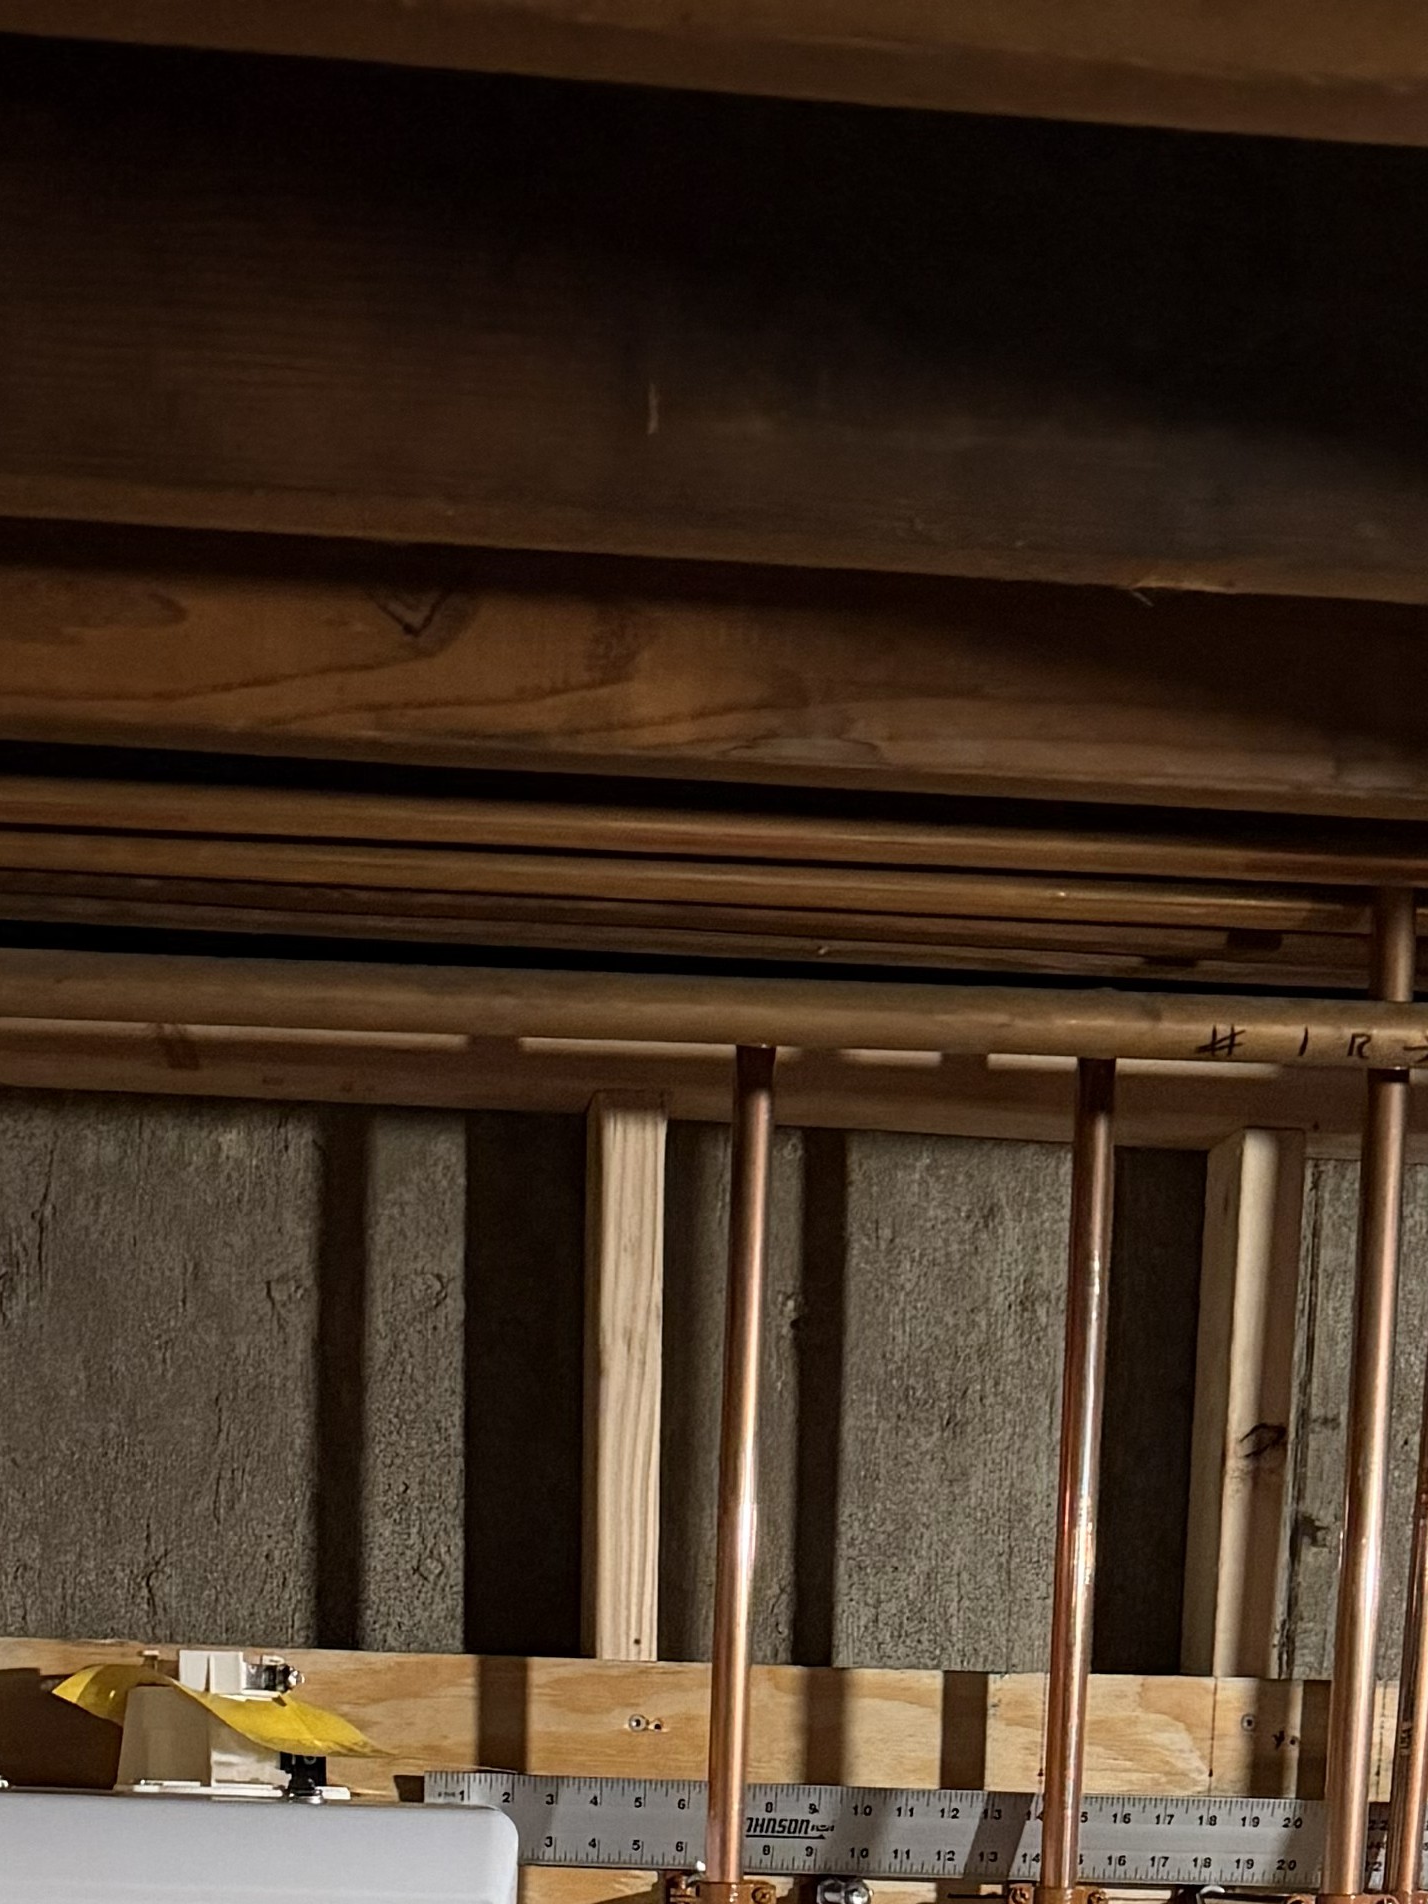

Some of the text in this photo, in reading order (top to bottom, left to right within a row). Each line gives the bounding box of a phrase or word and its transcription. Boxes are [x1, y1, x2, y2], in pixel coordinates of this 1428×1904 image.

[458, 1791, 465, 1802] 1
[502, 1792, 511, 1803] 2
[545, 1794, 554, 1805] 3
[589, 1795, 599, 1806] 4
[634, 1797, 643, 1808] 5
[677, 1799, 686, 1810] 6
[853, 1804, 872, 1816] 10
[896, 1807, 914, 1818] 11
[940, 1808, 959, 1820] 12
[983, 1809, 1002, 1820] 13
[1080, 1812, 1089, 1824] 5
[1112, 1813, 1131, 1824] 16
[1155, 1814, 1175, 1825] 17
[1198, 1815, 1218, 1826] 18
[1241, 1816, 1260, 1827] 19
[1282, 1817, 1303, 1829] 20
[544, 1836, 553, 1848] 3
[588, 1837, 597, 1849] 4
[632, 1840, 641, 1851] 5
[675, 1840, 684, 1852] 6
[762, 1845, 771, 1856] 8
[805, 1846, 813, 1857] 9
[850, 1847, 869, 1858] 10
[893, 1849, 910, 1860] 11
[936, 1850, 955, 1861] 12
[978, 1851, 998, 1862] 13
[1021, 1853, 1040, 1864] 14
[1107, 1855, 1126, 1866] 16
[1150, 1856, 1169, 1867] 17
[1193, 1857, 1212, 1869] 18
[1235, 1858, 1254, 1870] 19
[1276, 1859, 1297, 1871] 20
